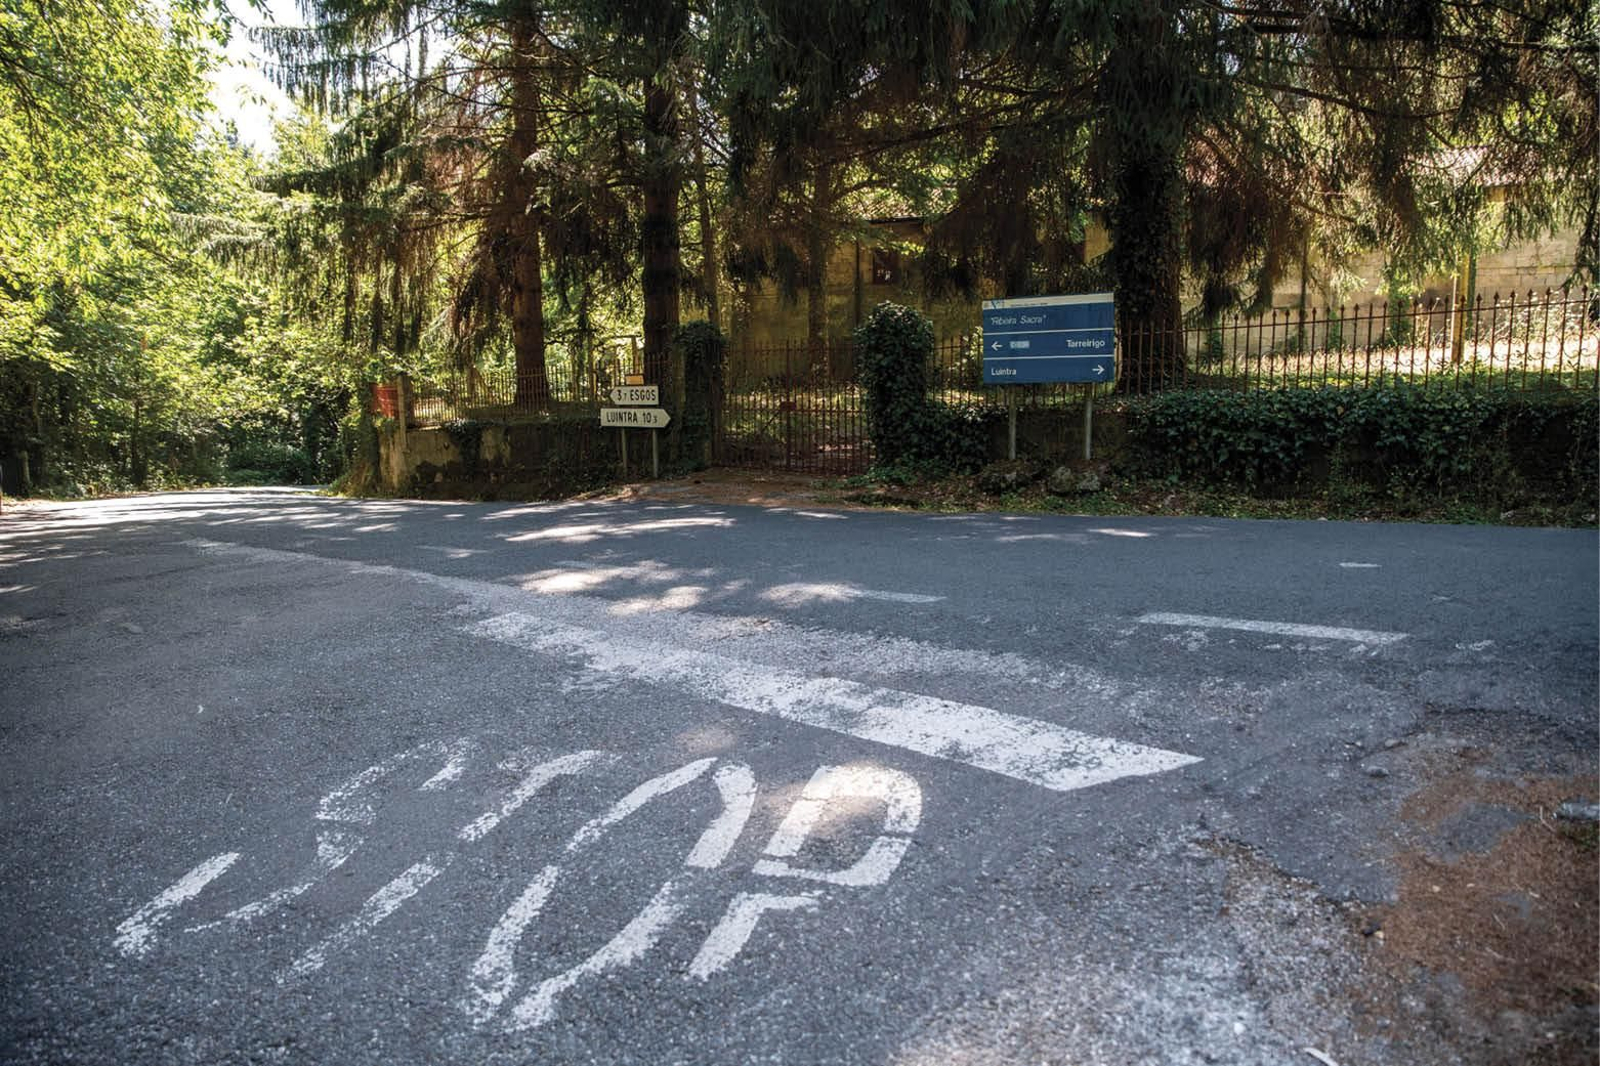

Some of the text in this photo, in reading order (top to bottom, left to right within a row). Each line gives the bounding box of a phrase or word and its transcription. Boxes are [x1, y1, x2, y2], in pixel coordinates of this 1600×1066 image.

[630, 389, 656, 401] ESGOS
[606, 411, 638, 423] LUINTRA
[113, 736, 923, 1033] STOP
